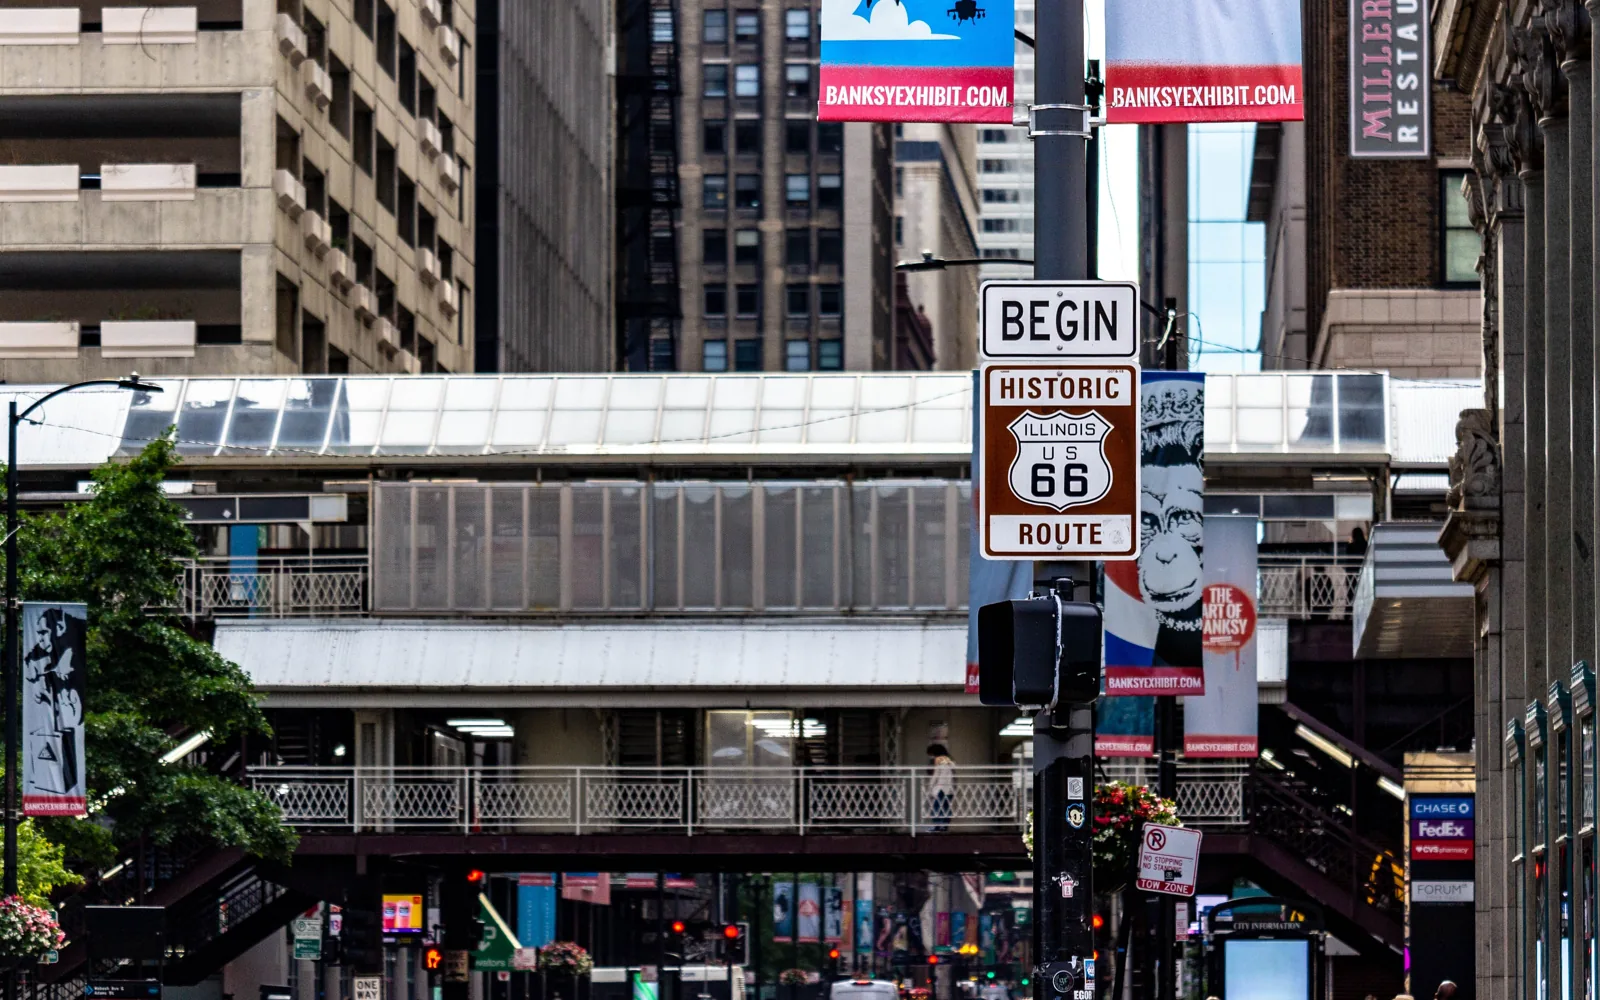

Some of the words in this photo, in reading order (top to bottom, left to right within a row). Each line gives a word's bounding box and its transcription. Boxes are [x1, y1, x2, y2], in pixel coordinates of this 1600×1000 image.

[826, 85, 1007, 107] BANKSYEXHIBIT.COM
[1112, 85, 1295, 107] BANKSYEXHIBIT.COM
[1002, 300, 1117, 341] BEGIN
[1000, 377, 1119, 399] HISTORIC
[1025, 423, 1096, 436] ILLINOIS
[1043, 446, 1054, 460] U
[1066, 446, 1077, 460] S
[1031, 463, 1088, 497] 66
[1019, 523, 1102, 545] ROUTE
[1209, 587, 1233, 604] THE
[1226, 603, 1243, 619] OF
[1202, 619, 1248, 635] ANKSY
[1109, 677, 1202, 689] BANKSYEXHIBIT.COM
[1186, 743, 1256, 753] BANKSYEXHIBIT.COM
[1415, 804, 1456, 813] CHASE
[1419, 822, 1465, 837] FedEx
[1155, 857, 1183, 866] STOPPING
[1141, 880, 1160, 890] TOW
[1164, 882, 1189, 893] ZONE
[1233, 922, 1249, 930] CITY
[1251, 922, 1300, 930] INFORMATION
[357, 981, 377, 990] ONE
[357, 991, 377, 1000] WAY
